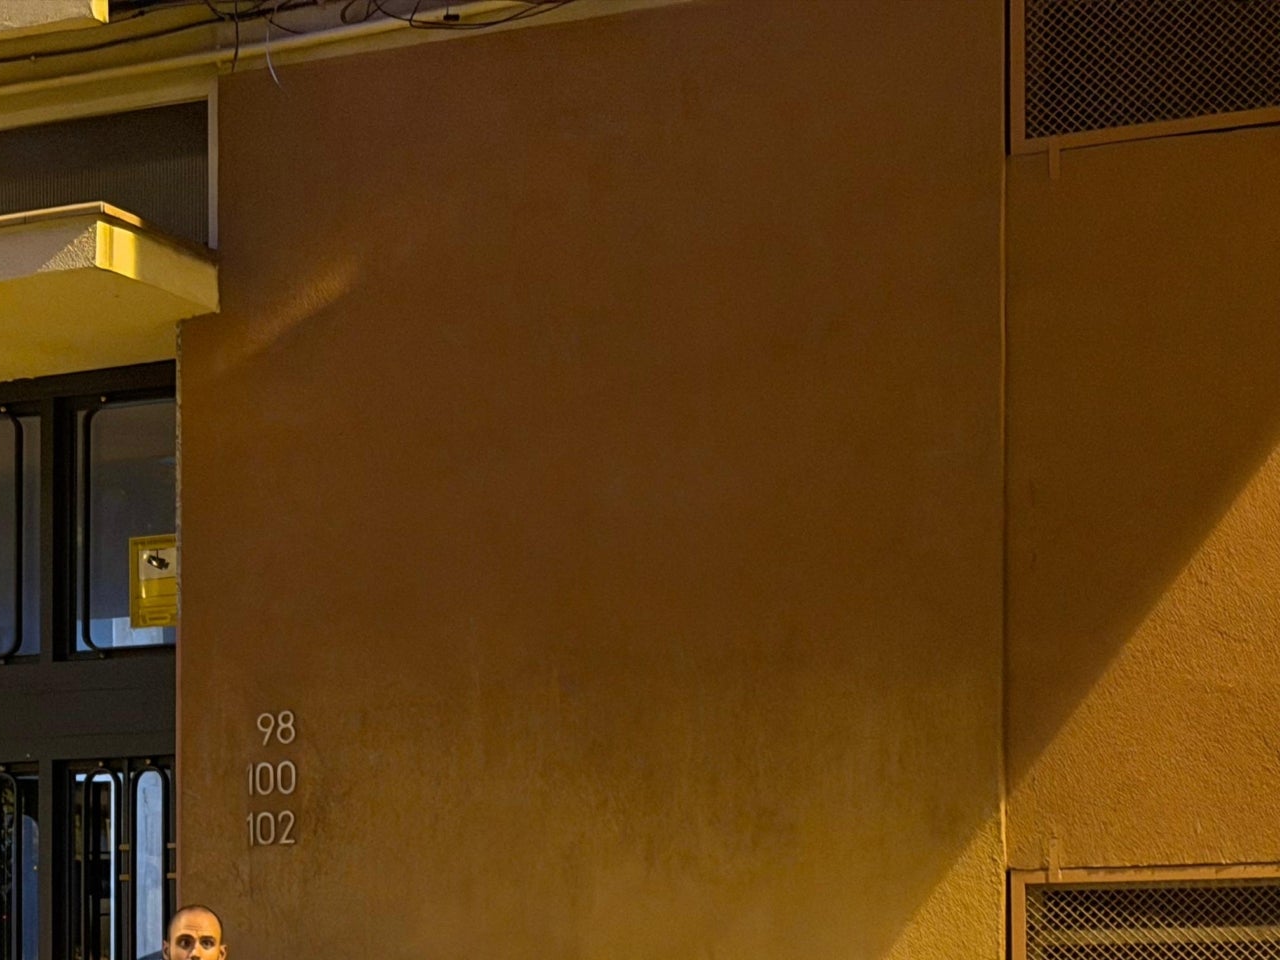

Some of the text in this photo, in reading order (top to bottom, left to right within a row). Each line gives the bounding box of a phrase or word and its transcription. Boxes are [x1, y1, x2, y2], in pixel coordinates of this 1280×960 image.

[257, 710, 296, 746] 98
[247, 760, 297, 796] 100
[246, 810, 296, 846] 102
